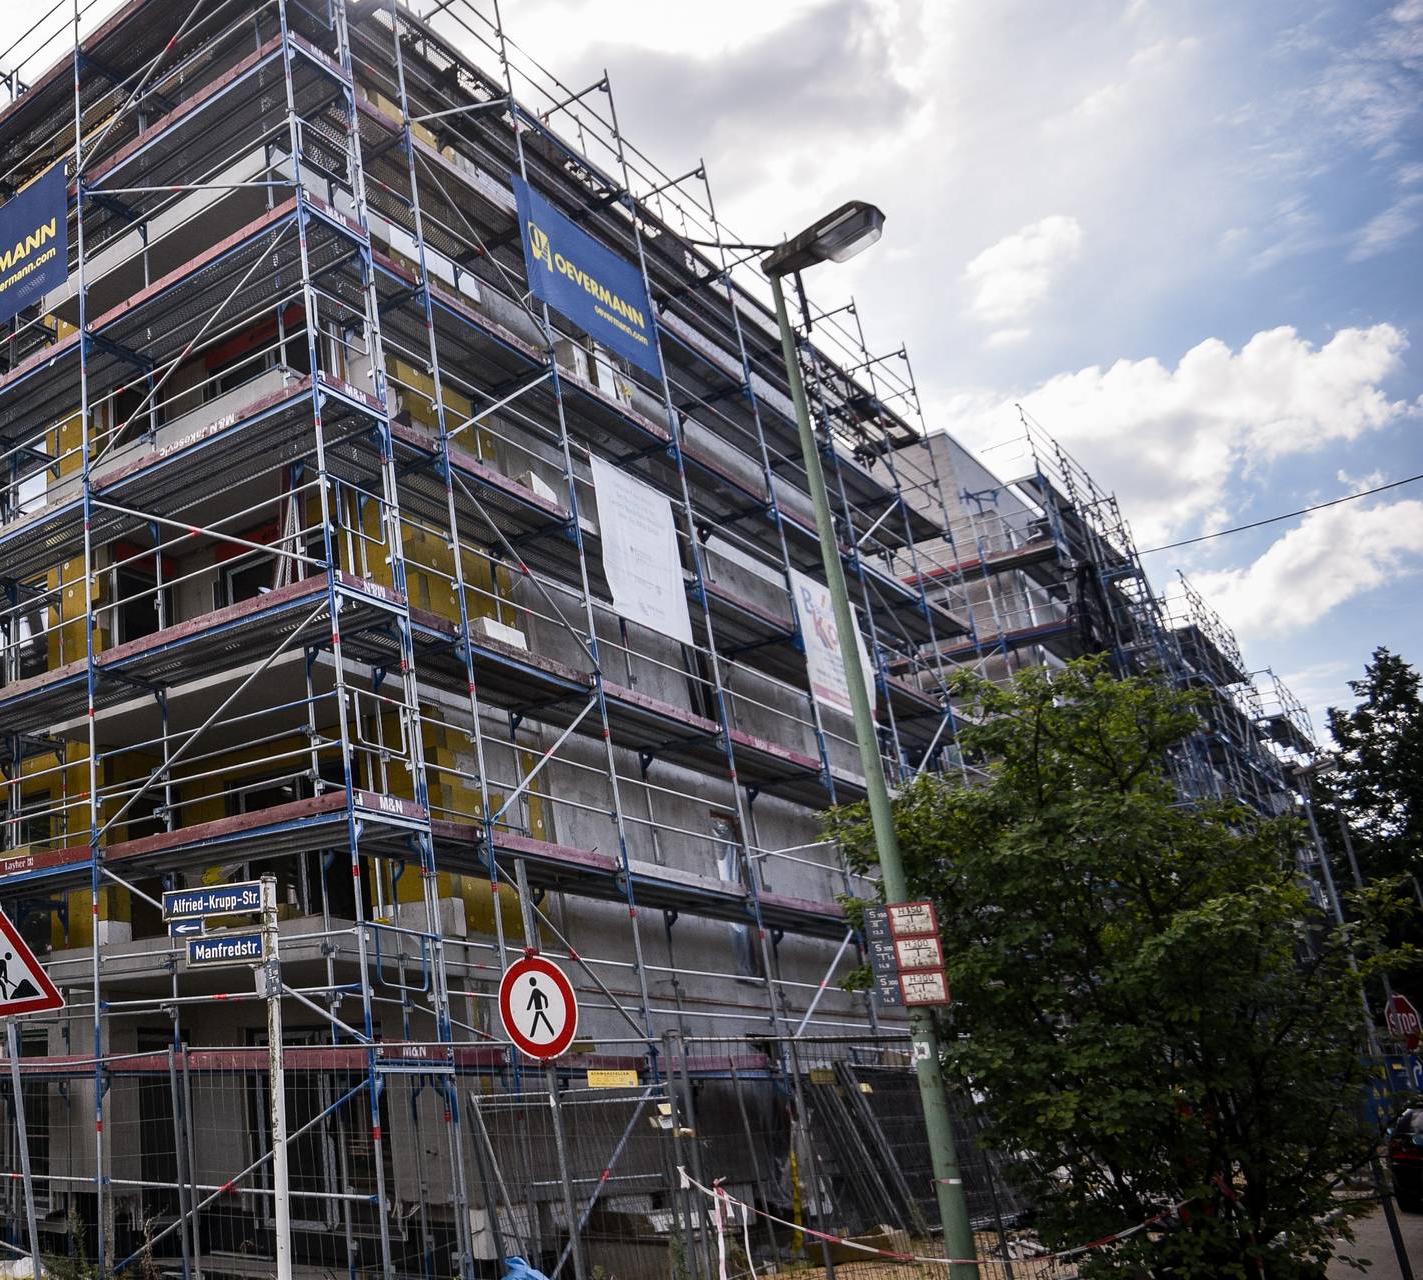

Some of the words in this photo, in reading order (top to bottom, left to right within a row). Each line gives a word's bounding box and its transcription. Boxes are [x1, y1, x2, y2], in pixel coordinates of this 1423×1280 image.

[554, 253, 646, 329] OEVERMANN
[379, 796, 403, 814] M&N
[172, 891, 259, 914] Alfried-Krupp-Str.
[195, 941, 261, 960] Manfredstr.
[402, 1046, 427, 1057] M&N
